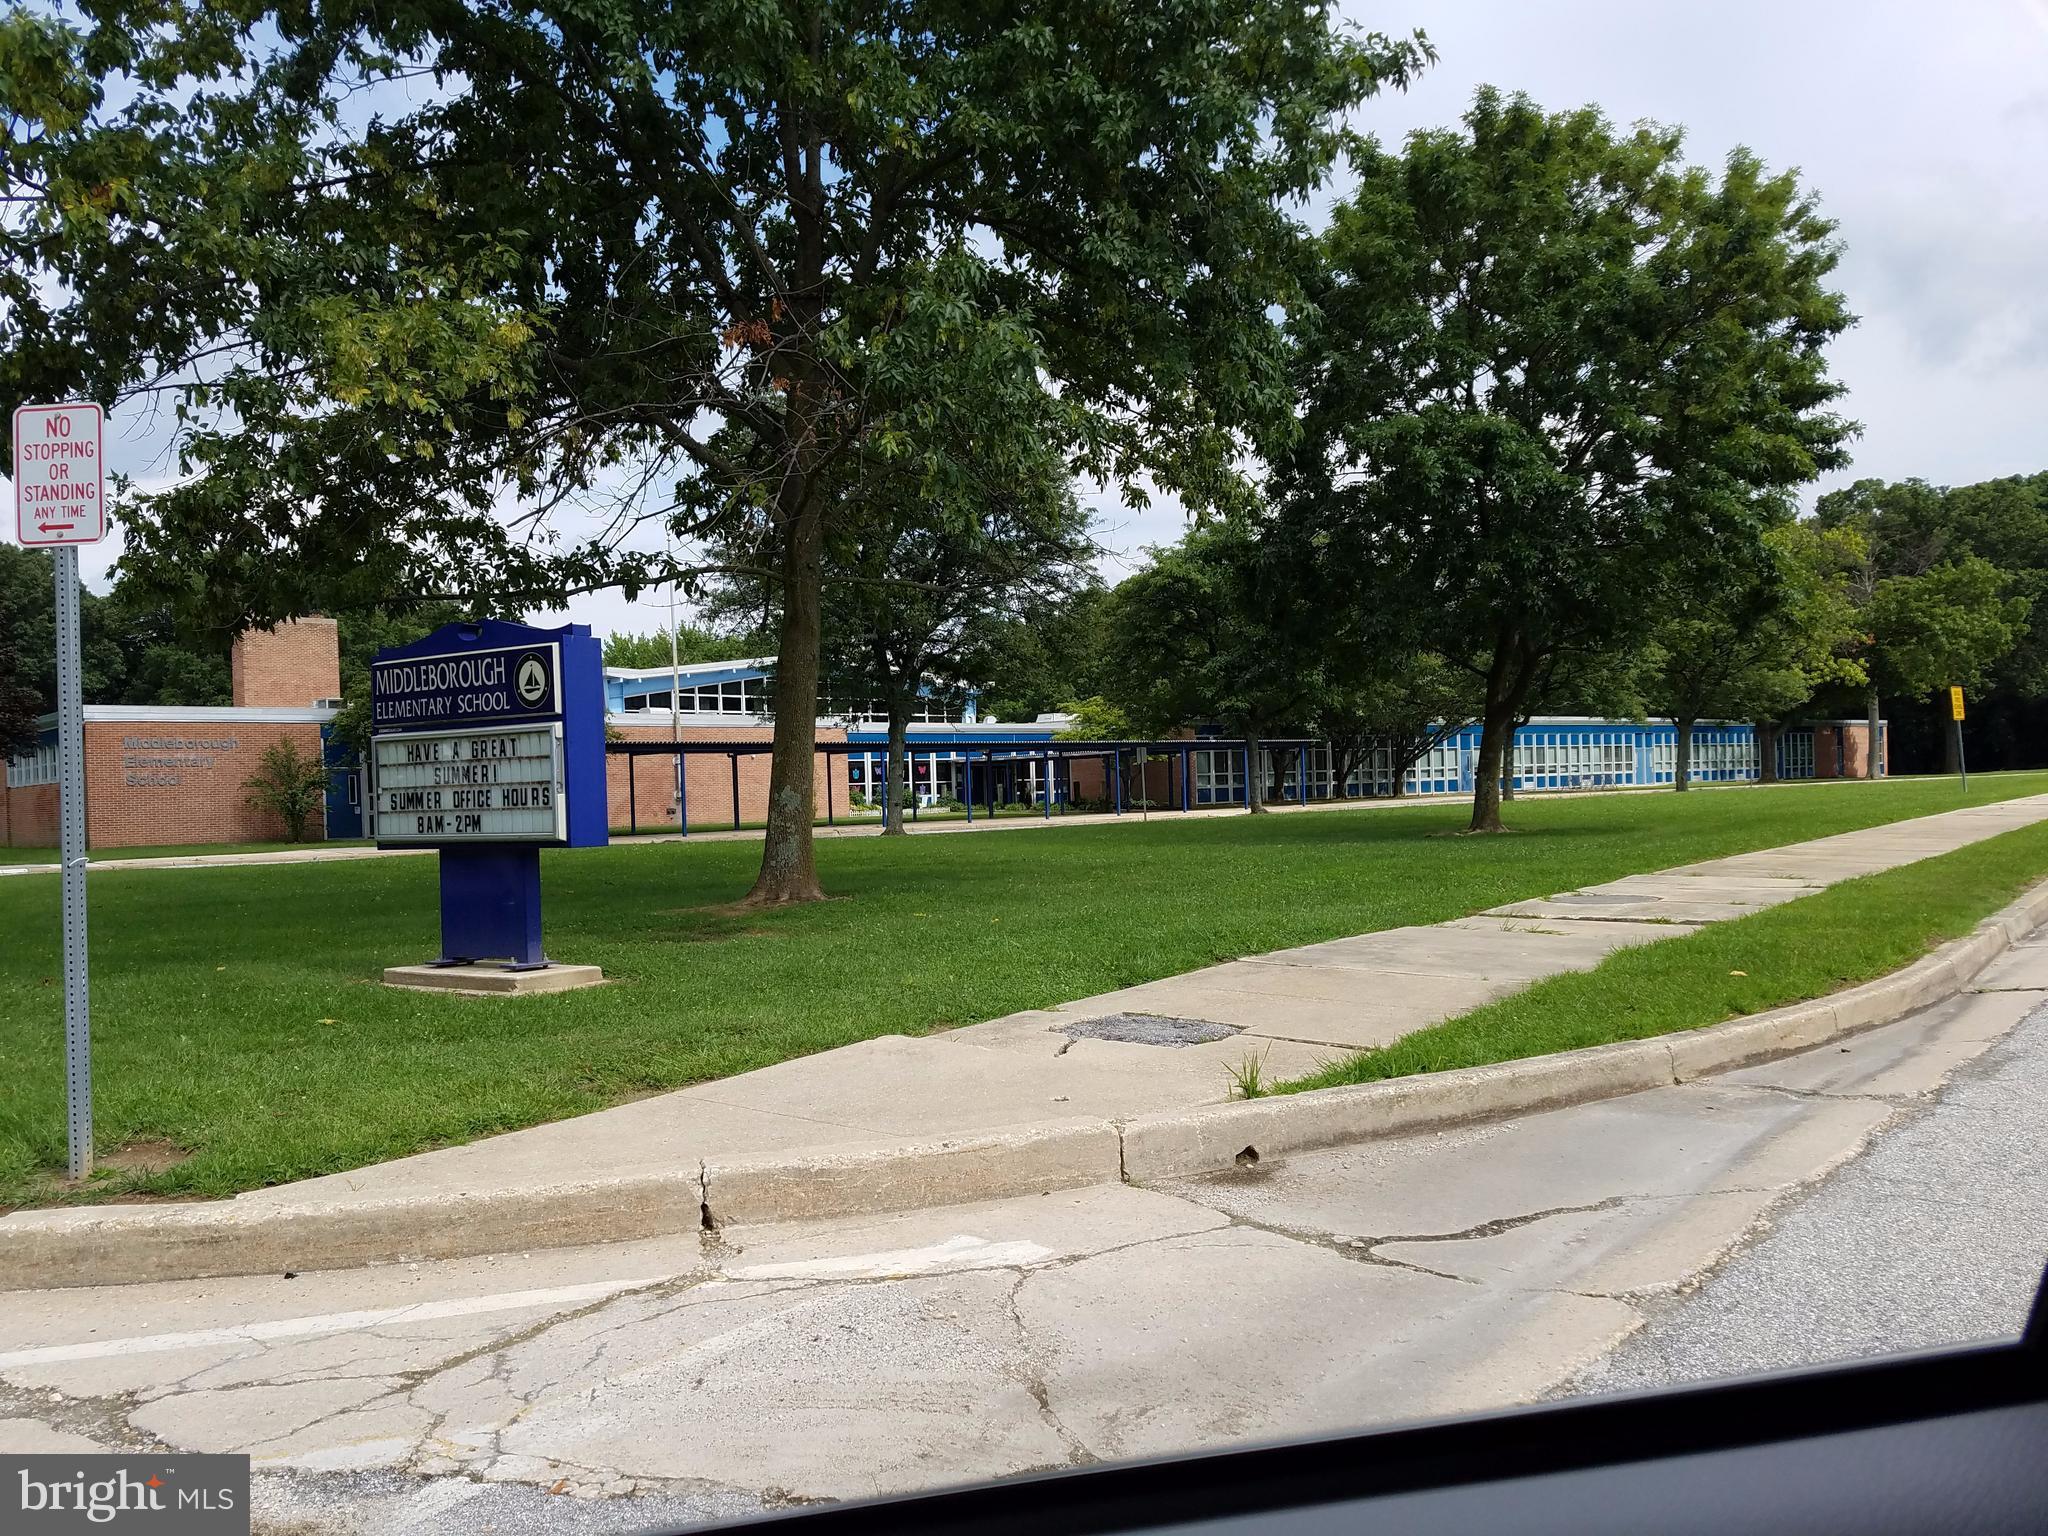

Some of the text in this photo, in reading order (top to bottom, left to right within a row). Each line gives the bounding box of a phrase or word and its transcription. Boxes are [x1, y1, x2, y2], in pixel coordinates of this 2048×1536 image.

[46, 416, 71, 438] NO
[24, 441, 94, 461] STOPPING
[49, 463, 69, 480] OR
[24, 482, 95, 502] STANDING
[34, 505, 87, 520] ANY TIME
[376, 657, 506, 696] MIDDLEBOROUGH
[376, 691, 511, 720] ELEMENTARY SCHOOL
[407, 738, 517, 762] HAVE A GREAT
[434, 764, 497, 785] SUMMER!
[390, 787, 550, 810] SUMMER OFFICE HOURS
[417, 814, 482, 834] 8AM-2PM
